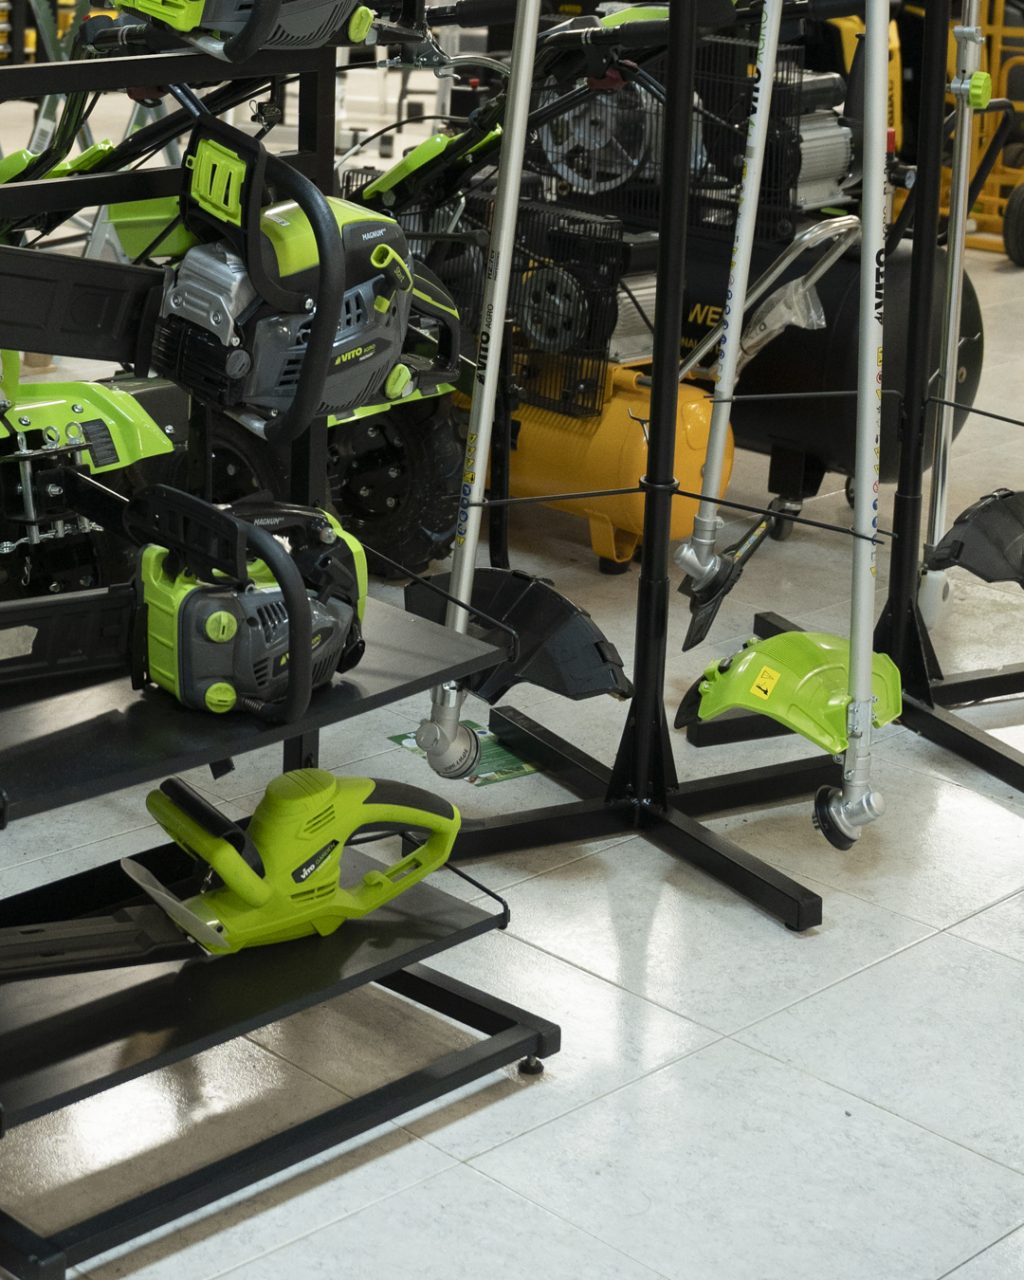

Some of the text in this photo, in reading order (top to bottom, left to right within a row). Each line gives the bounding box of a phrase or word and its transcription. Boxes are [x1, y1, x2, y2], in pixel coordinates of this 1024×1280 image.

[362, 230, 384, 240] MAGNUM
[339, 347, 363, 362] VITO
[477, 331, 491, 371] VITO
